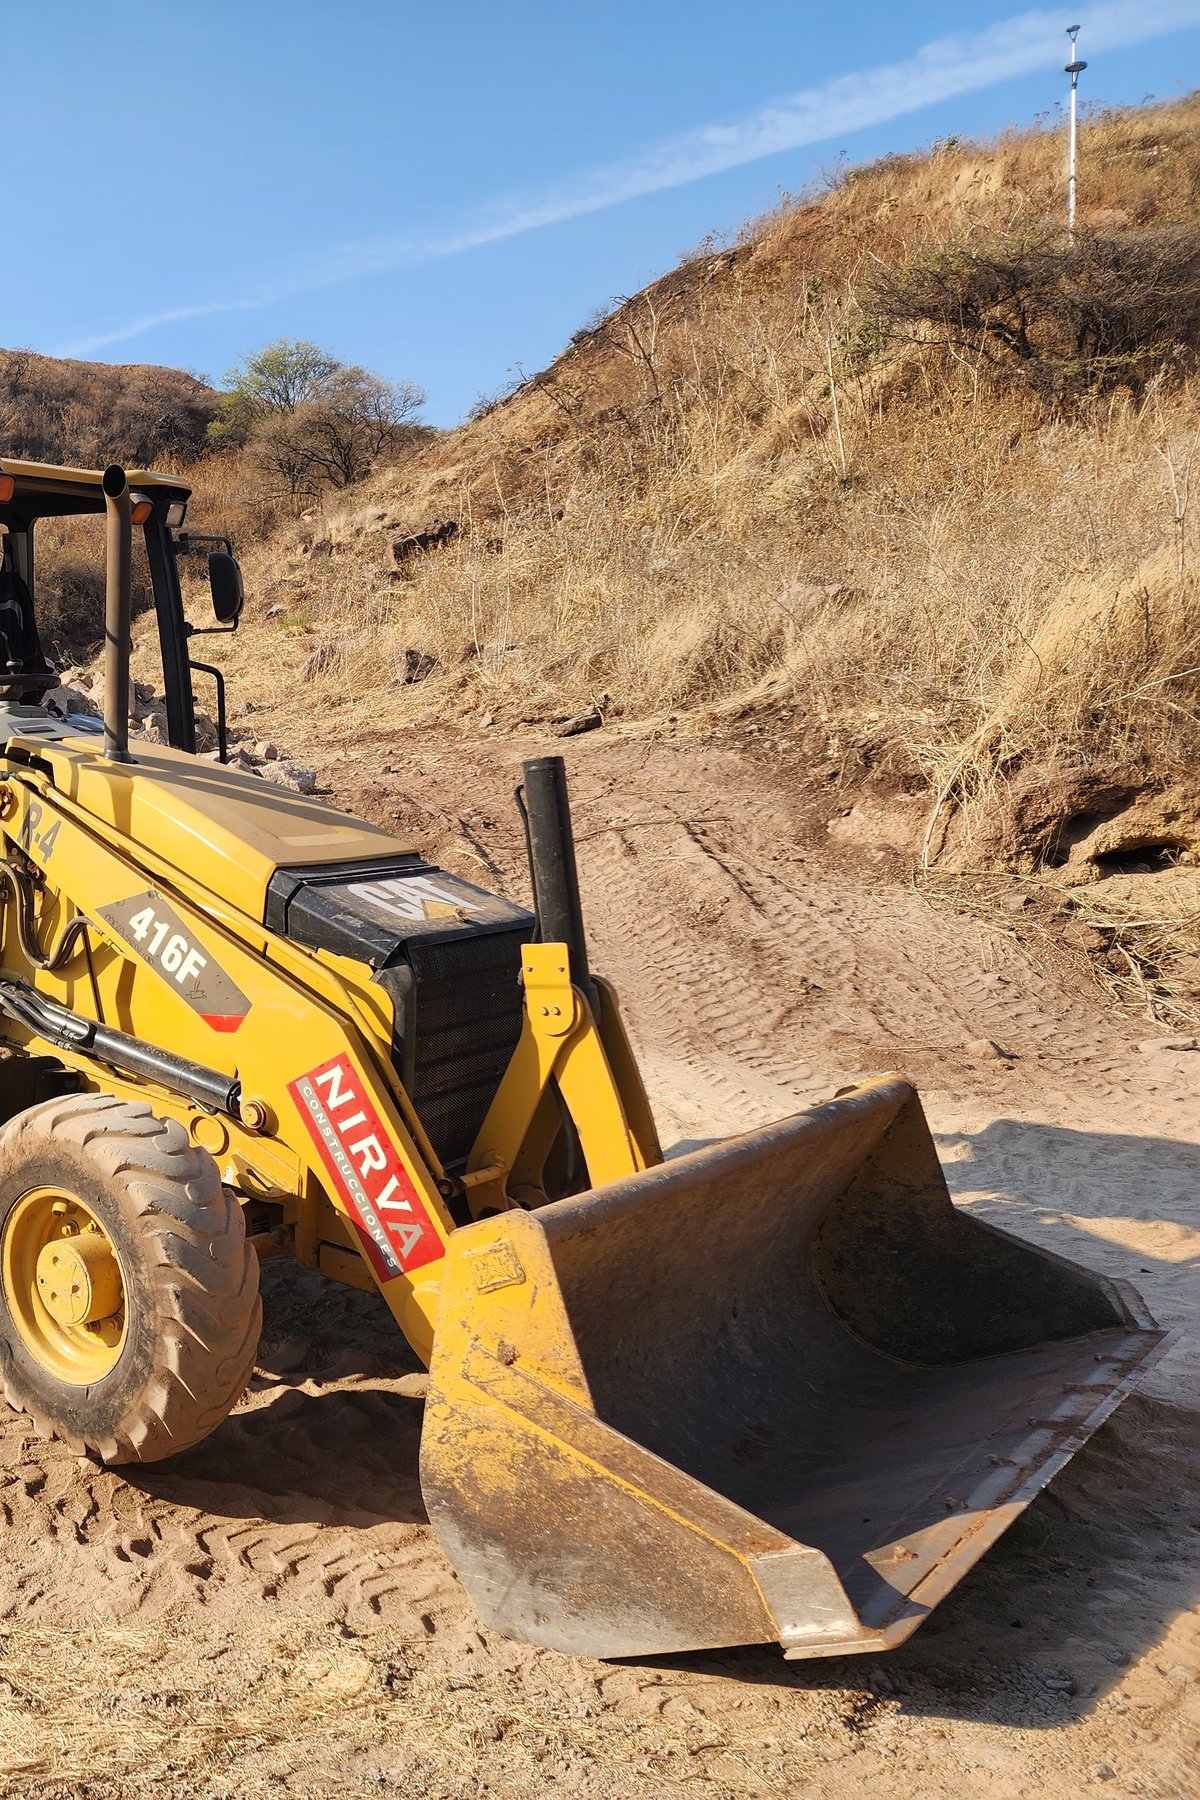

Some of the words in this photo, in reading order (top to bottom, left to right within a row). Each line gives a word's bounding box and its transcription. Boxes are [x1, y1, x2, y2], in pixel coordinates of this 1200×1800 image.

[129, 907, 207, 983] 416F
[348, 877, 484, 921] CAT
[303, 1086, 397, 1268] CONSTRUCCIONES
[315, 1064, 424, 1259] NIRVA
